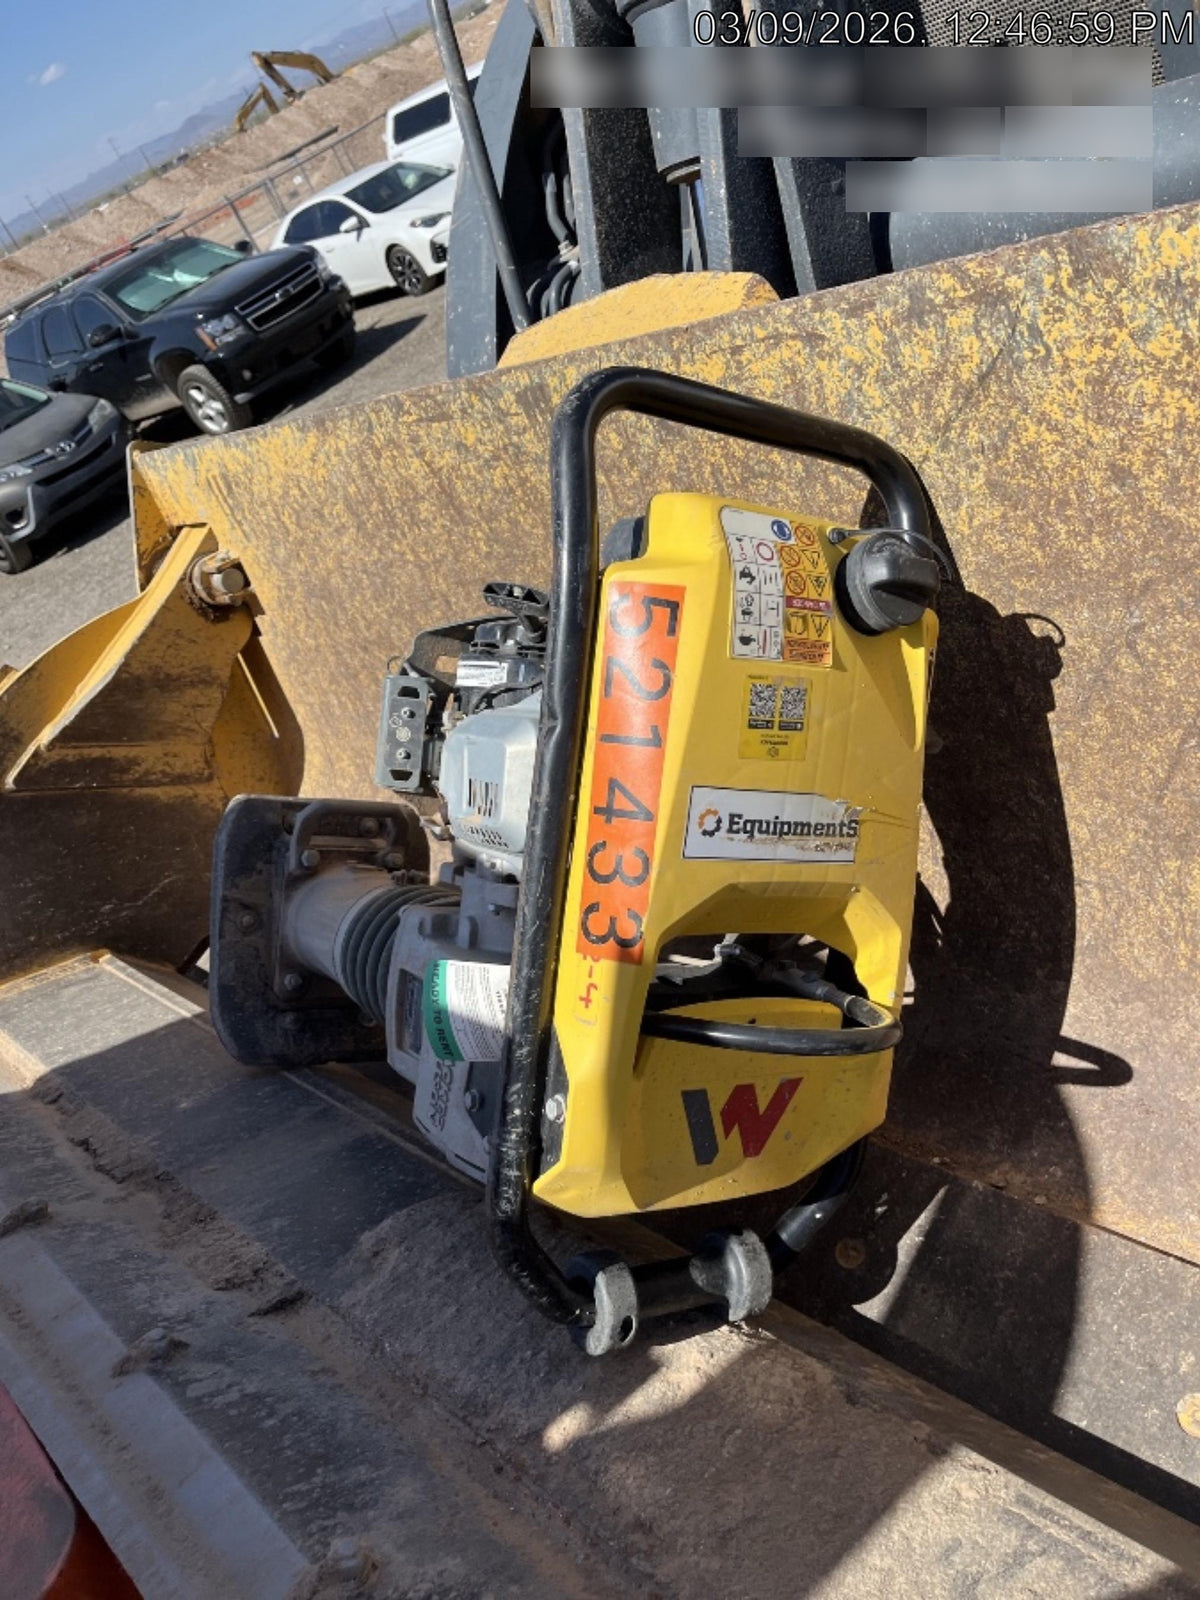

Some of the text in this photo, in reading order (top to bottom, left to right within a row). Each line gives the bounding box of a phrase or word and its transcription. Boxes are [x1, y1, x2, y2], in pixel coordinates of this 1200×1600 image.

[581, 594, 680, 948] 521433
[432, 1010, 444, 1026] TO
[435, 1027, 455, 1057] RENT
